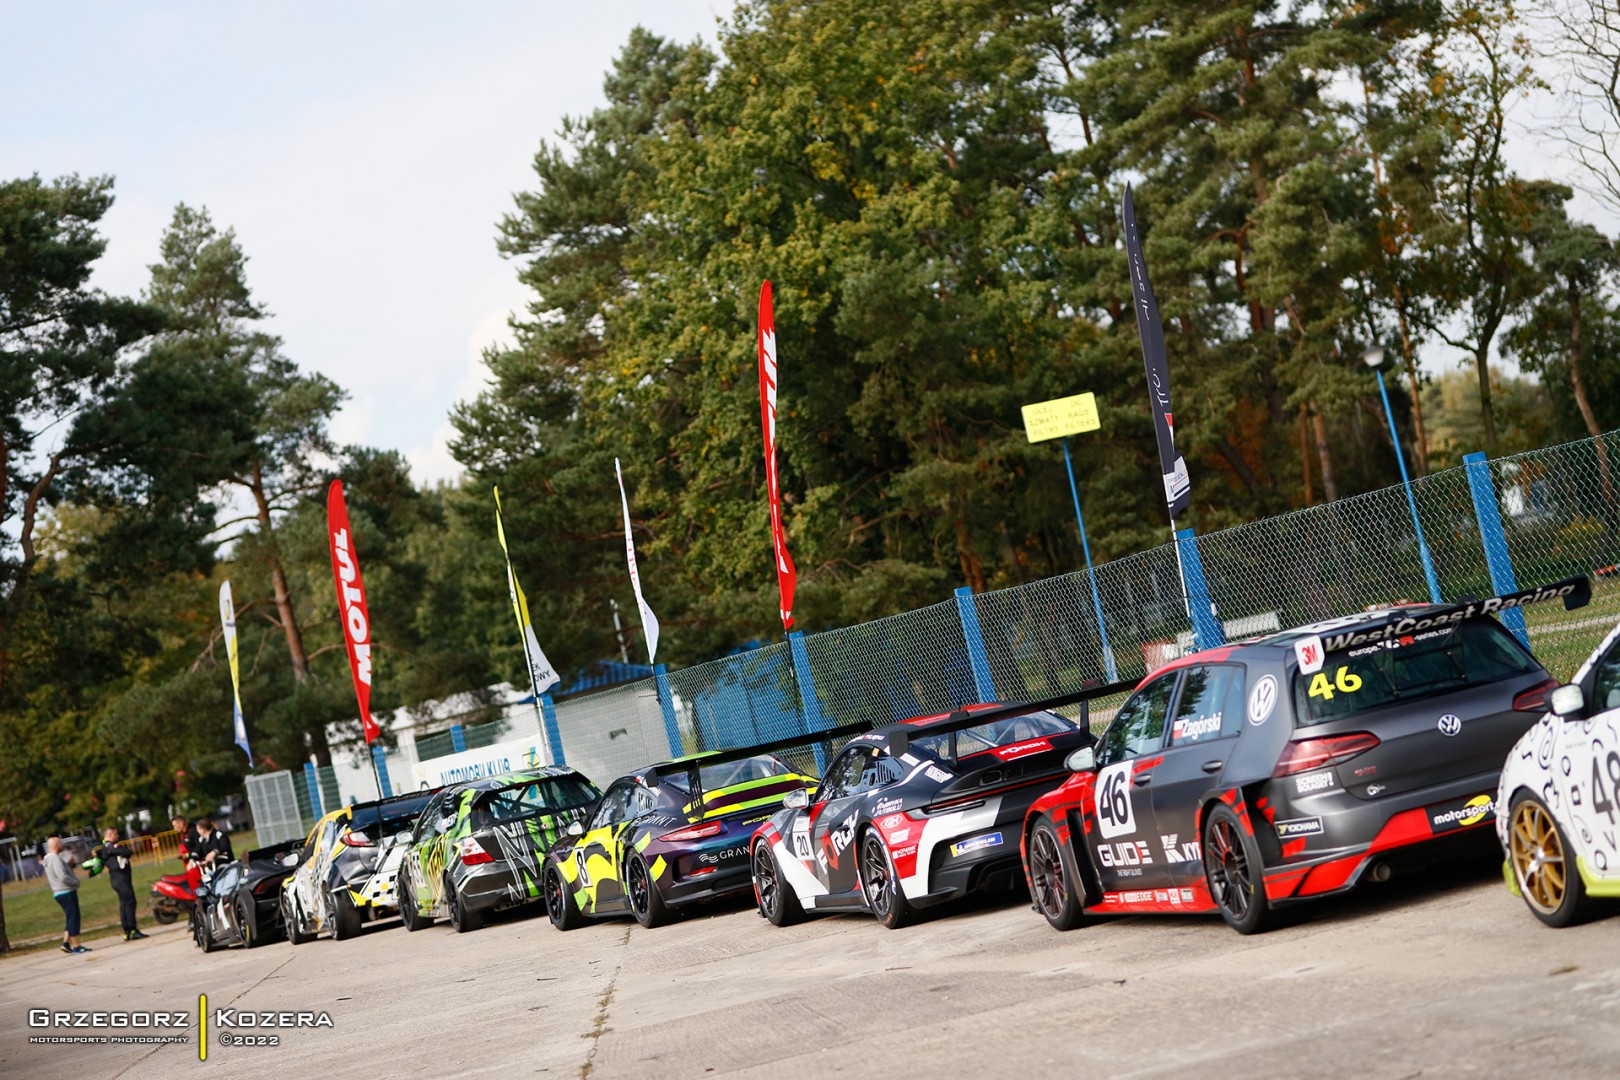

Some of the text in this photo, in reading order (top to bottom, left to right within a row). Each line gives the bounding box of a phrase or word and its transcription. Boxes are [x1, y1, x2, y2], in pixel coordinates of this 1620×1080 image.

[334, 527, 372, 687] MOTUL
[1325, 582, 1576, 651] WestCoast Racing
[1303, 643, 1319, 666] 3M
[1308, 665, 1363, 700] 46
[1181, 711, 1222, 740] Zagórski
[1100, 770, 1128, 827] 46
[797, 835, 810, 857] 20
[1097, 841, 1153, 867] GUIDE
[576, 851, 587, 883] 8
